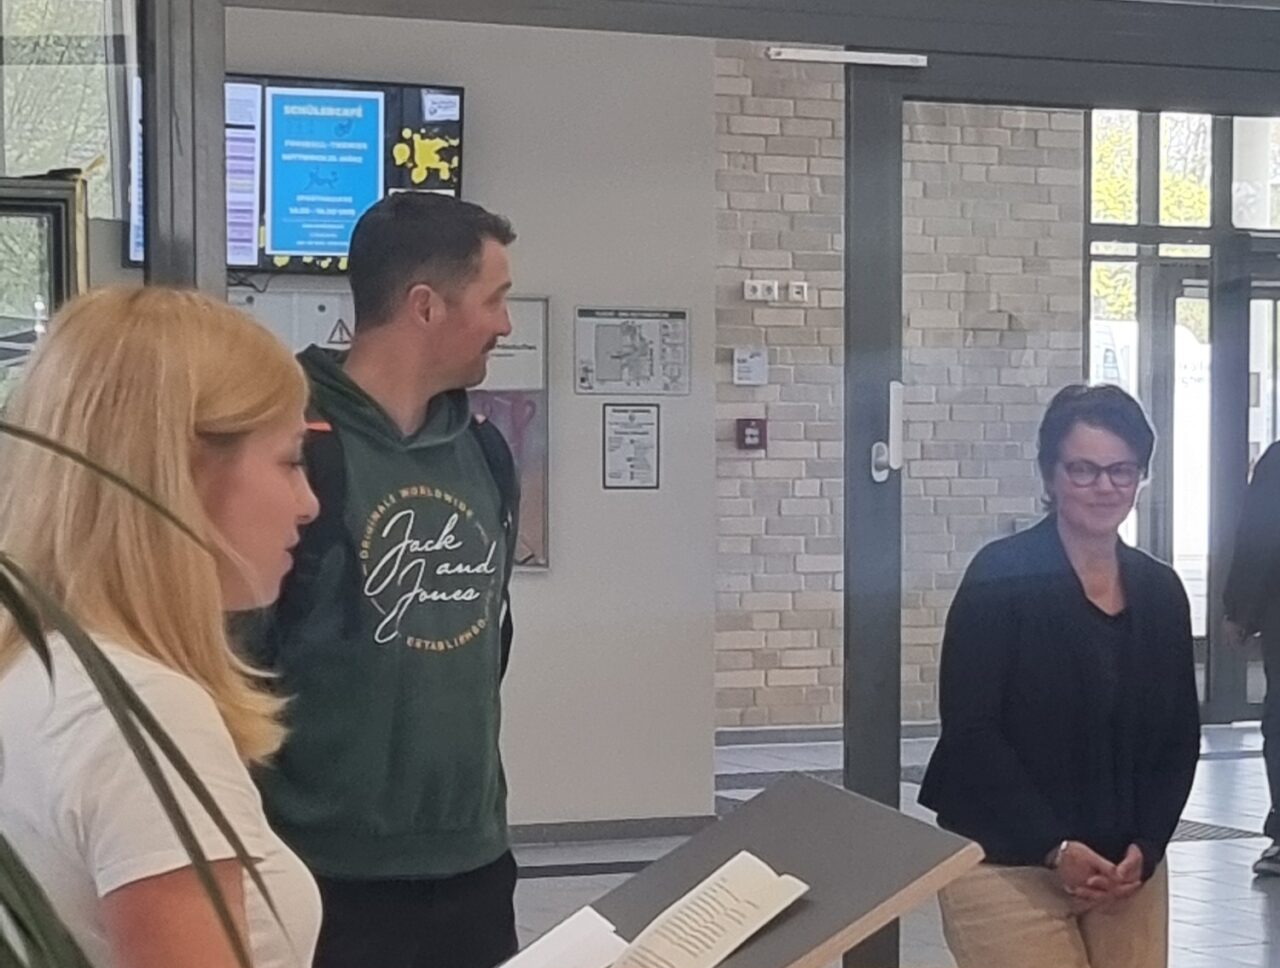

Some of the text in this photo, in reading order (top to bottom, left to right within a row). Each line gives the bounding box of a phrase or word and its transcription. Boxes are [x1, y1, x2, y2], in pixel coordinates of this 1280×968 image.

[399, 485, 473, 520] WORLDWIDE
[364, 510, 463, 596] Jack
[436, 541, 496, 575] and
[375, 559, 480, 643] Jones
[406, 618, 486, 651] ESTABLISHED
